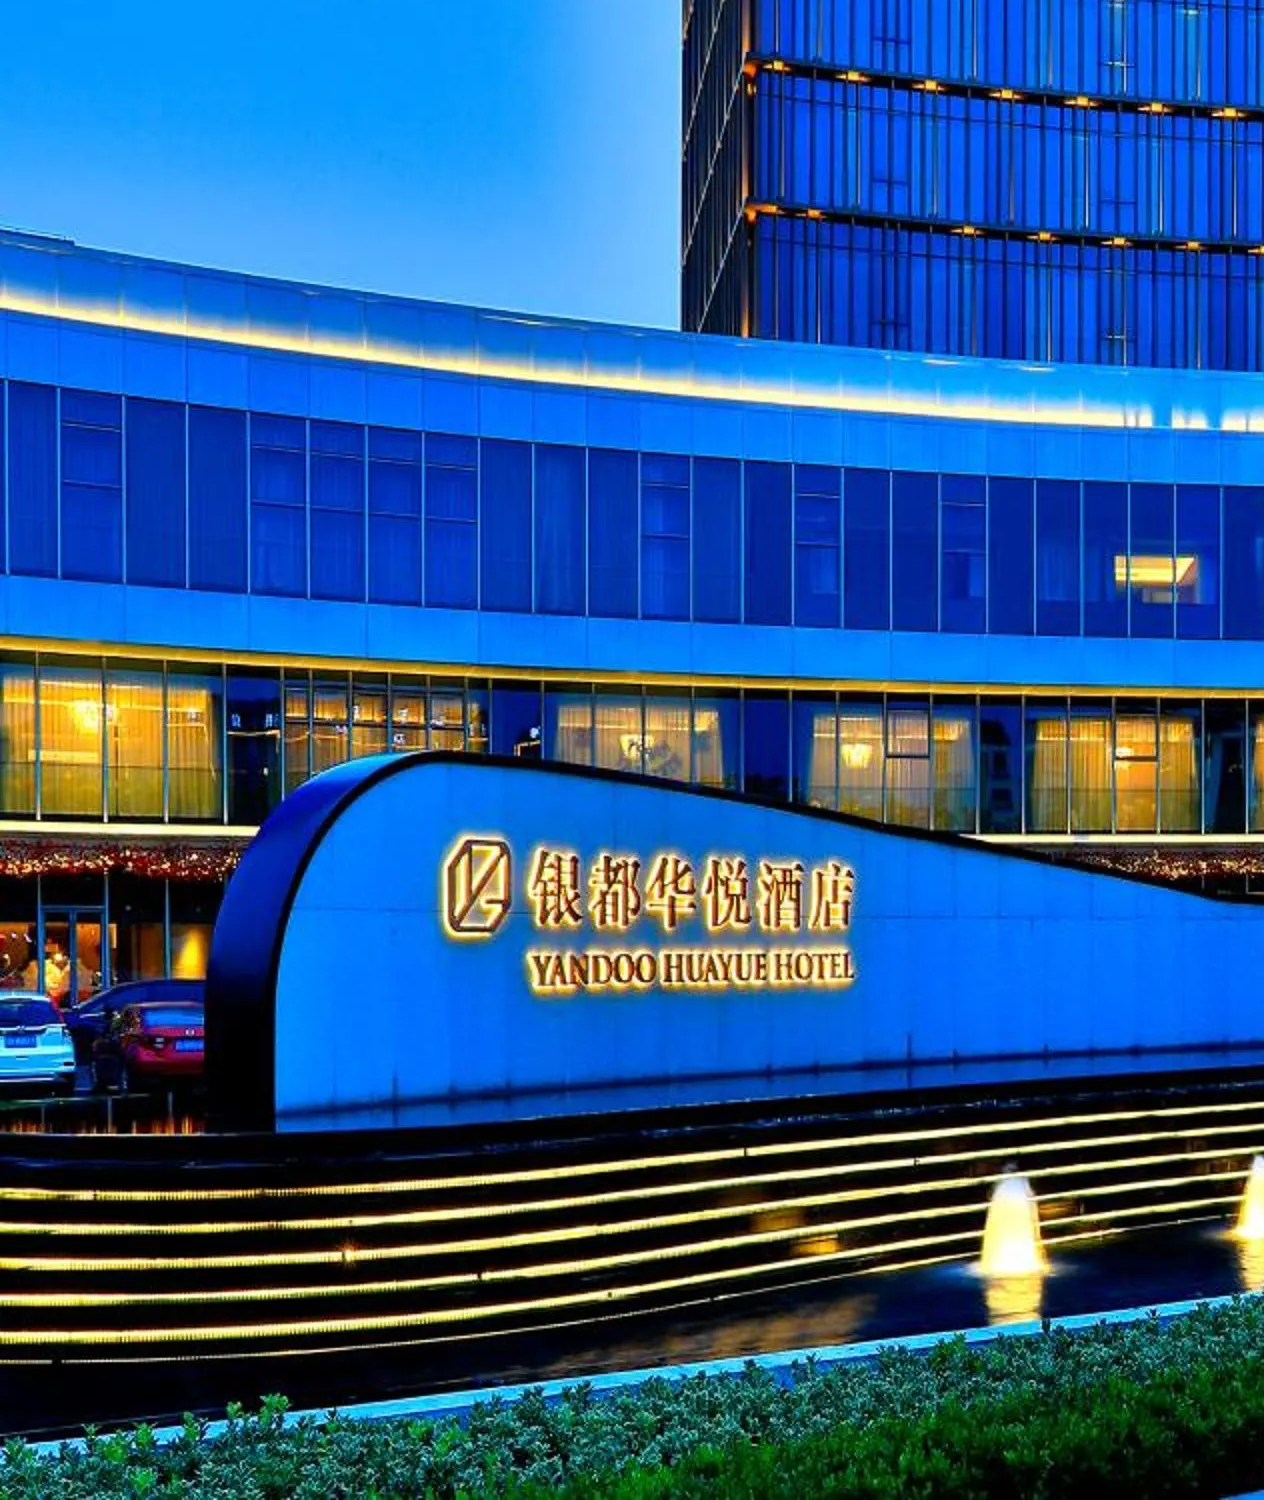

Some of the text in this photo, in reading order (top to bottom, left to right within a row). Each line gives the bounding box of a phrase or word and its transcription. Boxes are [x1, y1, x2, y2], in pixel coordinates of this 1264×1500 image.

[530, 847, 855, 929] 银都华悦酒店
[530, 950, 855, 986] YANDOO HUAYUE HOTEL
